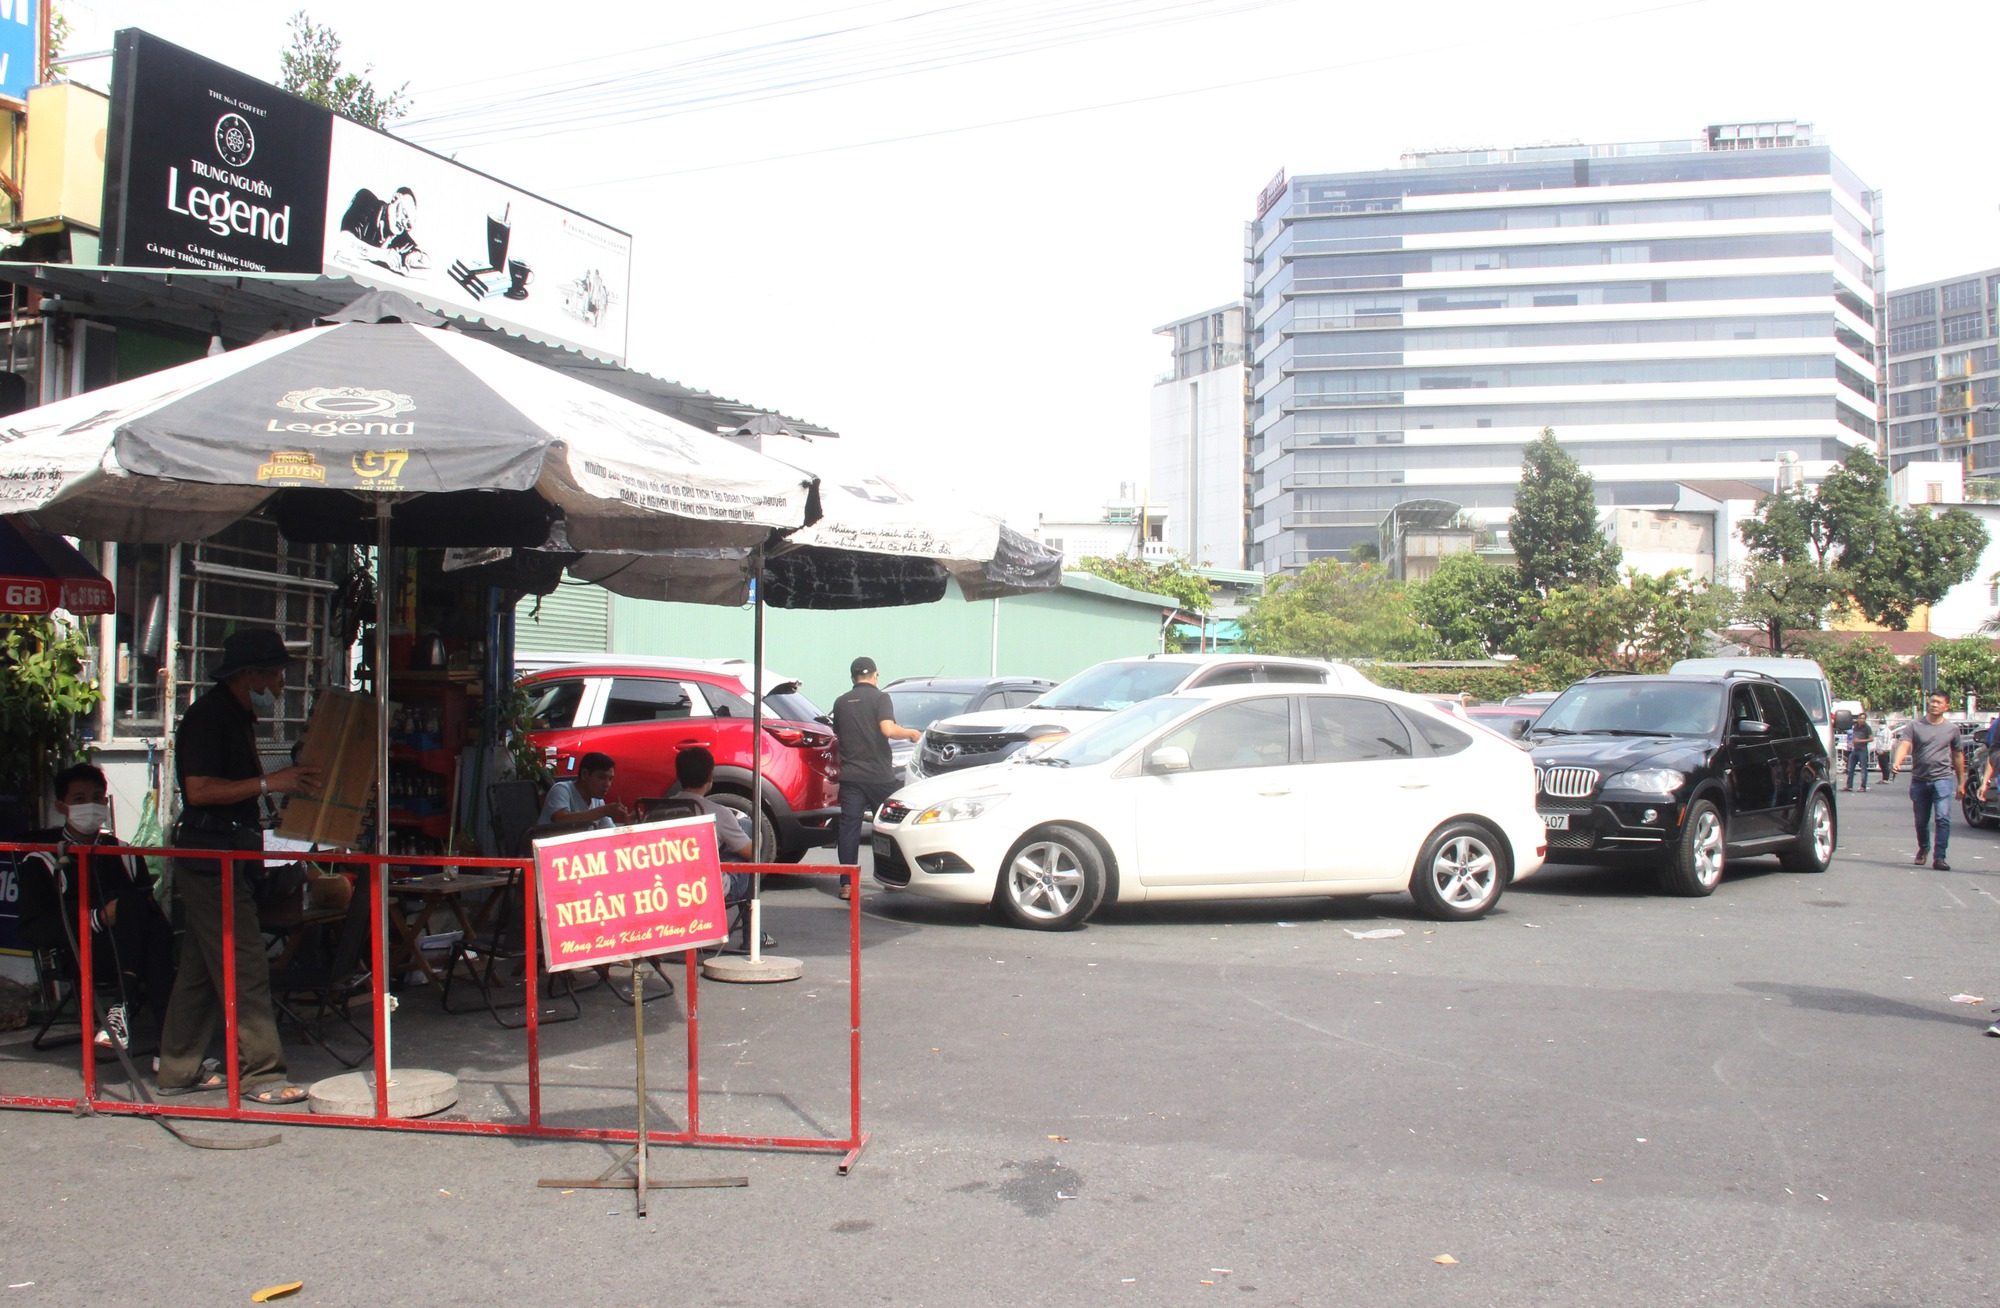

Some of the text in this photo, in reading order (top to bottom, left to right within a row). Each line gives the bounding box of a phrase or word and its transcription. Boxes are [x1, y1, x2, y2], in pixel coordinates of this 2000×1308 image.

[209, 89, 222, 100] THE
[238, 102, 267, 118] COFFEE!
[191, 159, 272, 198] TRUNG NGUYÊN
[168, 166, 291, 246] Legend
[146, 242, 158, 253] CÀ
[187, 243, 199, 254] CÀ
[240, 259, 266, 273] LƯỢNG
[267, 419, 414, 437] Legend
[275, 455, 309, 465] TRUNG
[352, 450, 409, 478] G7
[584, 460, 606, 478] Những
[6, 585, 42, 606] 68
[552, 850, 609, 885] TẠM
[556, 874, 708, 928] NHẬN HỒ SƠ
[560, 919, 714, 954] Mong Quý Khách Thông Cảm
